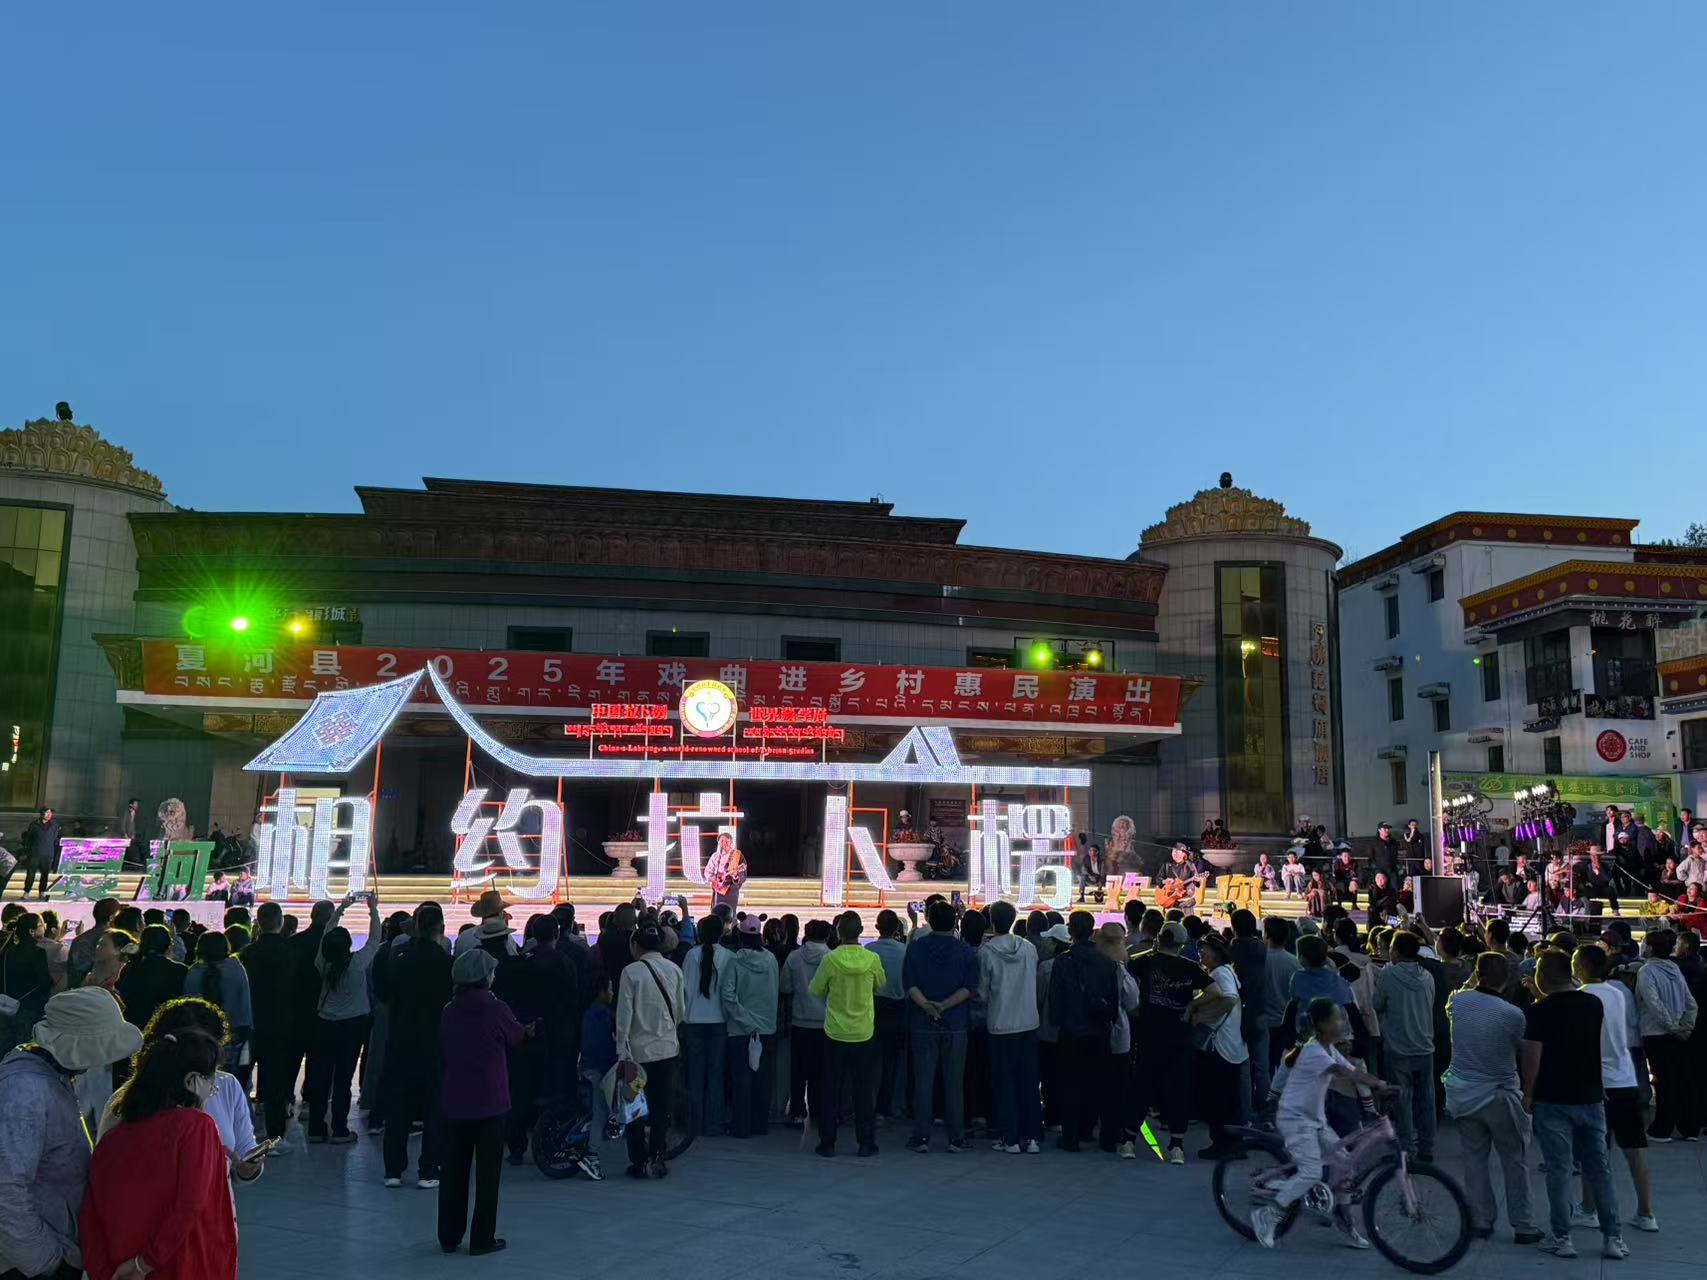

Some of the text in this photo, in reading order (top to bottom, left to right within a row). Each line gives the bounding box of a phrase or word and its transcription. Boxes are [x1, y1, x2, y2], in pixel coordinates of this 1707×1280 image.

[1628, 738, 1649, 746] CAFE
[1630, 752, 1651, 760] SHOP
[254, 787, 1077, 909] 相约拉卜楞
